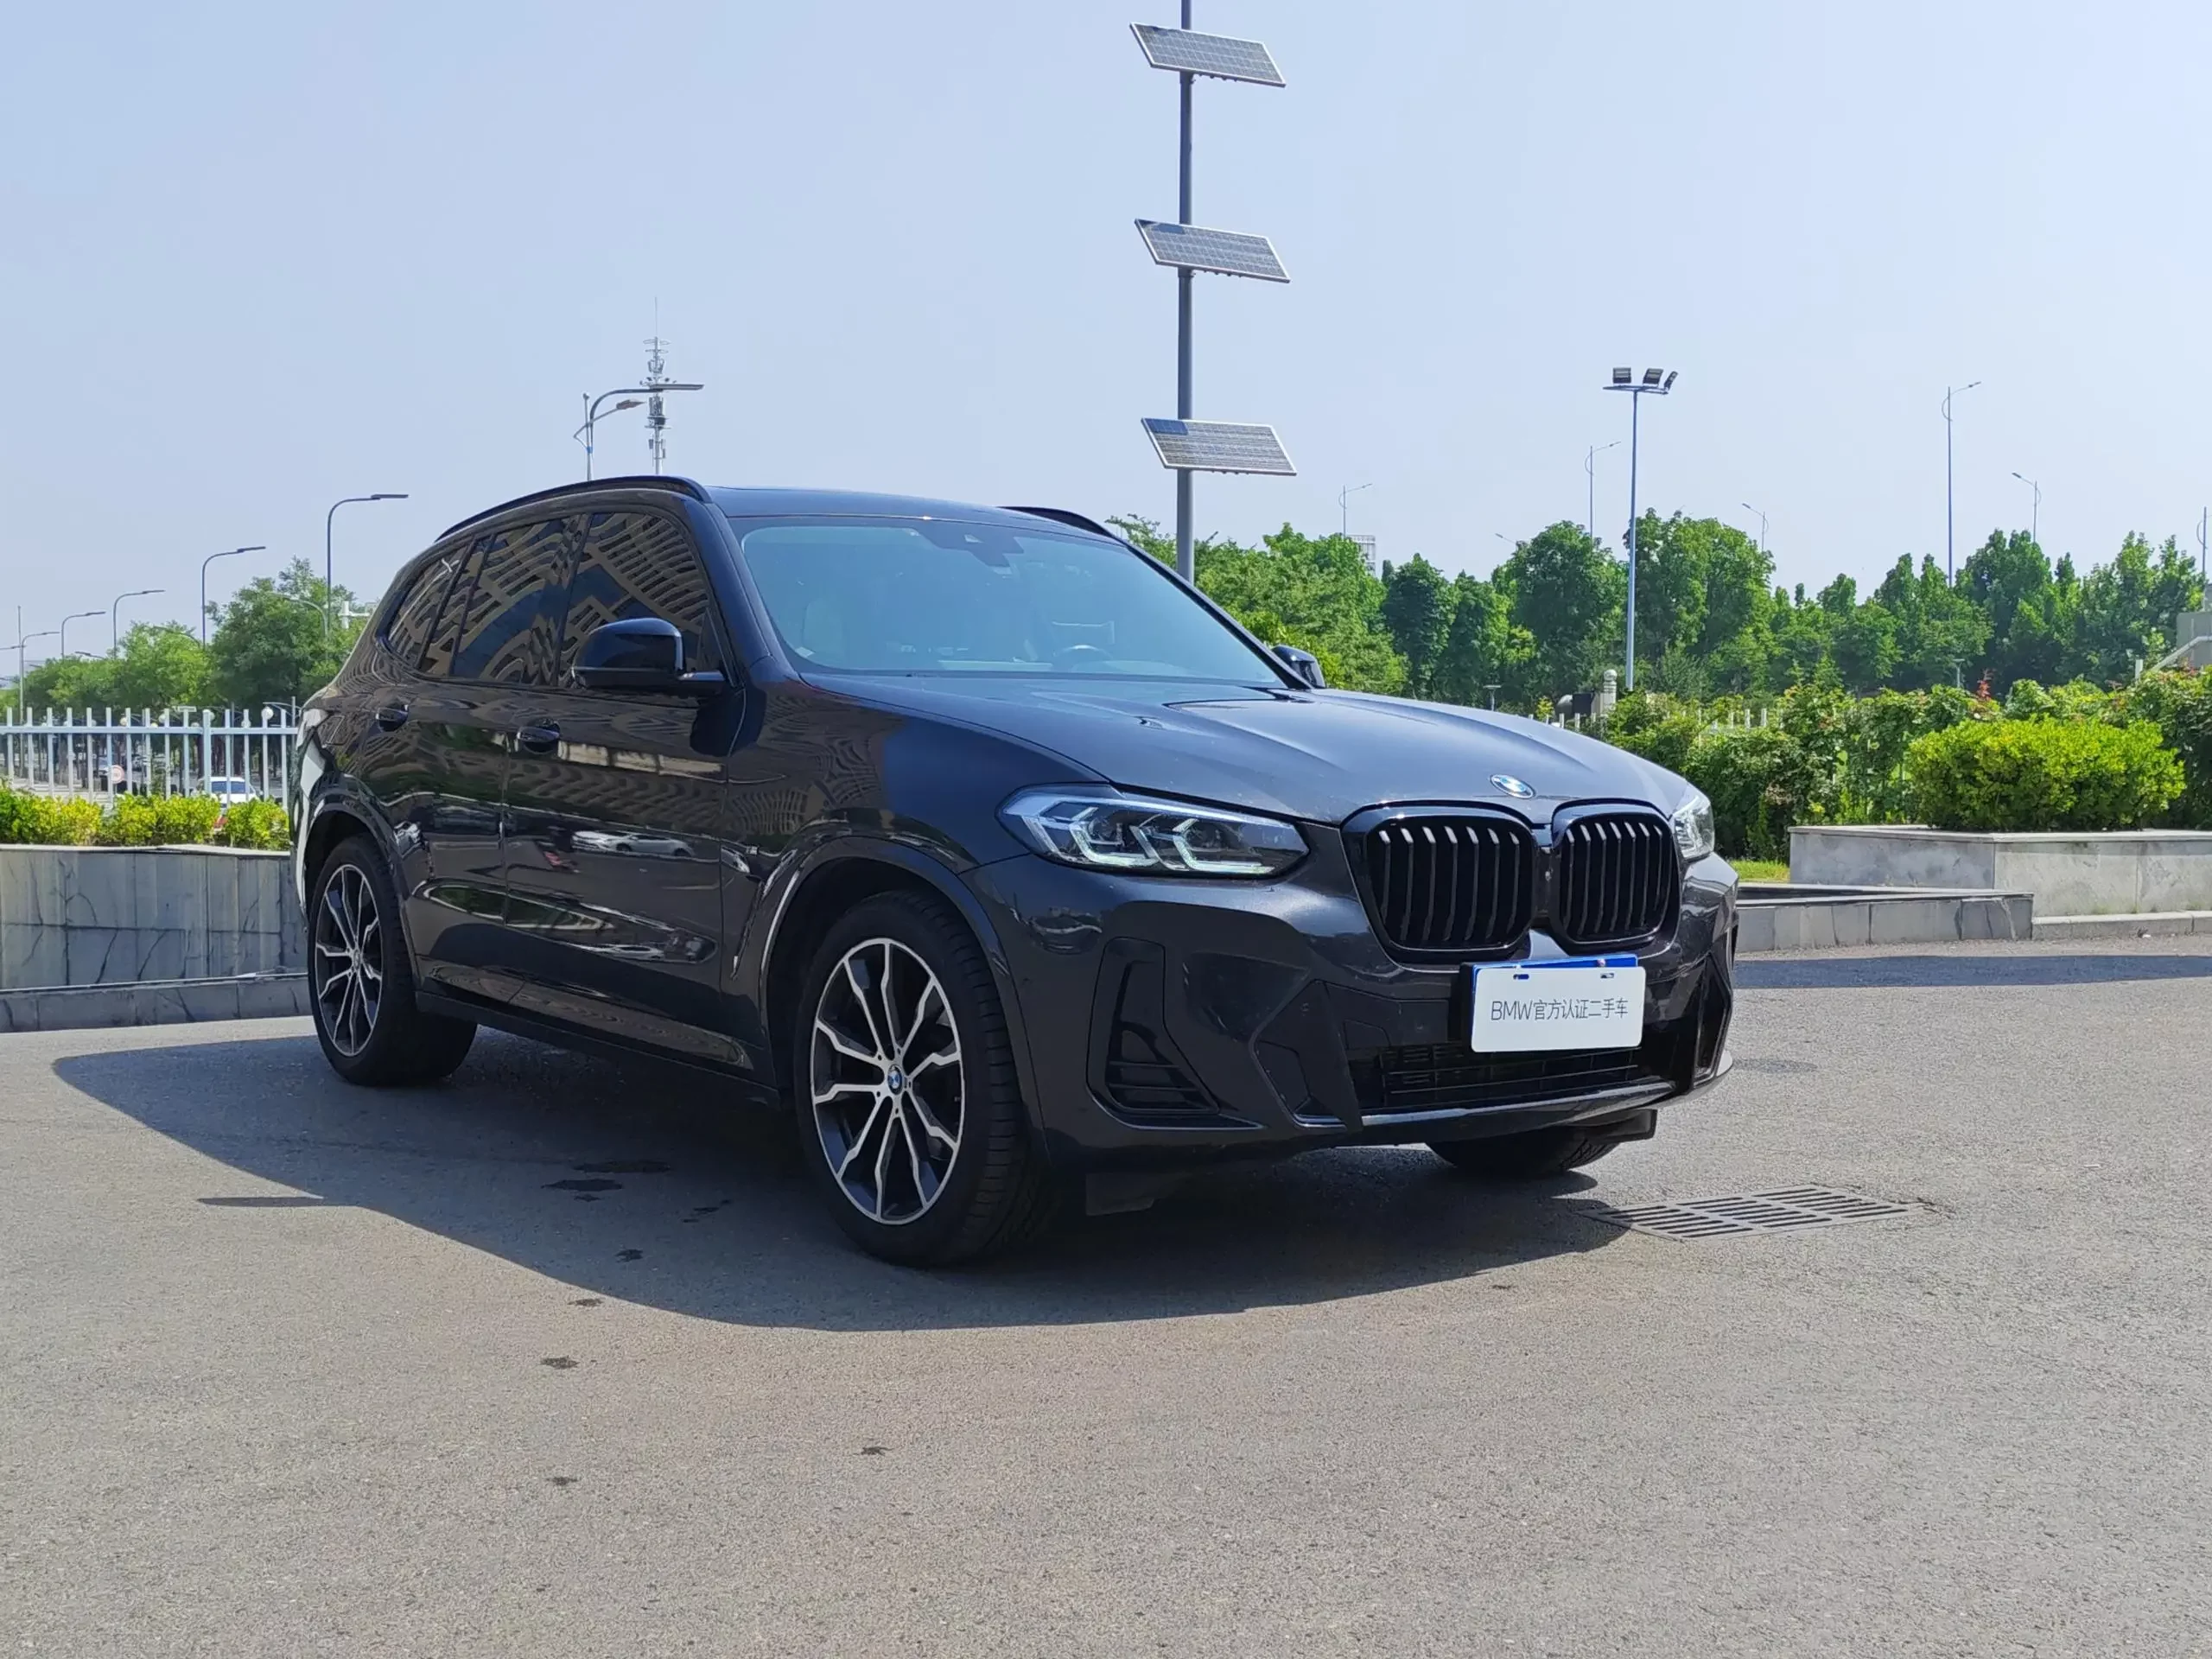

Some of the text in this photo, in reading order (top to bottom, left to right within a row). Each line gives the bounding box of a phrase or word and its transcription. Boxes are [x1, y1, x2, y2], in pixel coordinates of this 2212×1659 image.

[1491, 997, 1629, 1020] BMW官方认证二手车
